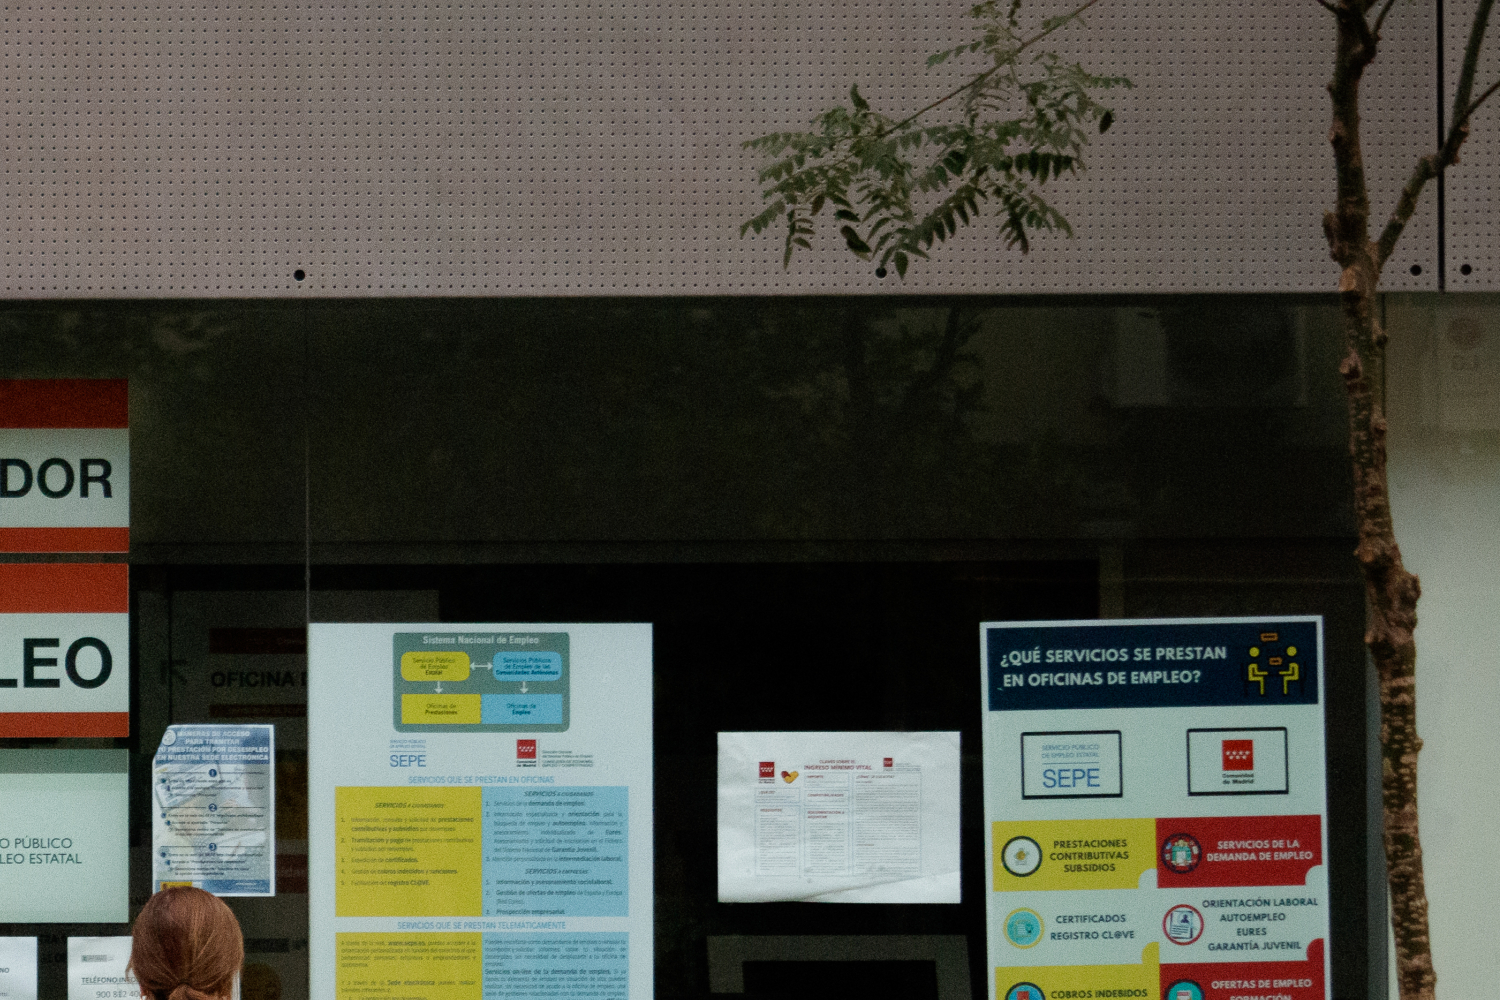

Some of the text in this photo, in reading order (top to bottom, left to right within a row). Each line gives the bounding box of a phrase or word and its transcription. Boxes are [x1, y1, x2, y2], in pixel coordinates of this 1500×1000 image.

[423, 635, 539, 646] Sistema Nacional de Empleo
[1000, 647, 1226, 667] ¿QUÉ SERVICIOS SE PRESTAN
[211, 671, 294, 687] OFICINA
[1004, 670, 1201, 687] EN OFICINAS DE EMPLEO?
[390, 754, 426, 767] SEPE
[409, 775, 554, 784] SERVICIOS QUE SE PRESTAN EN OFICINAS
[1042, 768, 1100, 789] SEPE
[14, 834, 73, 850] PÚBLICO
[1054, 839, 1128, 849] PRESTACIONES
[1217, 839, 1299, 849] SERVICIOS DE LA
[28, 853, 82, 864] ESTATAL
[1050, 851, 1129, 861] CONTRIBUTIVAS
[1207, 850, 1313, 862] DEMANDA DE EMPLEO
[1064, 863, 1116, 873] SUBSIDIOS
[1202, 896, 1318, 908] ORIENTACIÓN LABORAL
[1056, 914, 1126, 924] CERTIFICADOS
[1219, 912, 1286, 923] AUTOEMPLEO
[1050, 930, 1135, 941] REGISTRO CL@VE
[1236, 927, 1267, 937] EURES
[1208, 941, 1301, 952] GARANTÍA JUVENIL
[1211, 979, 1312, 990] OFERTAS DE EMPLEO
[1051, 989, 1148, 1000] COBROS INDEBIDOS
